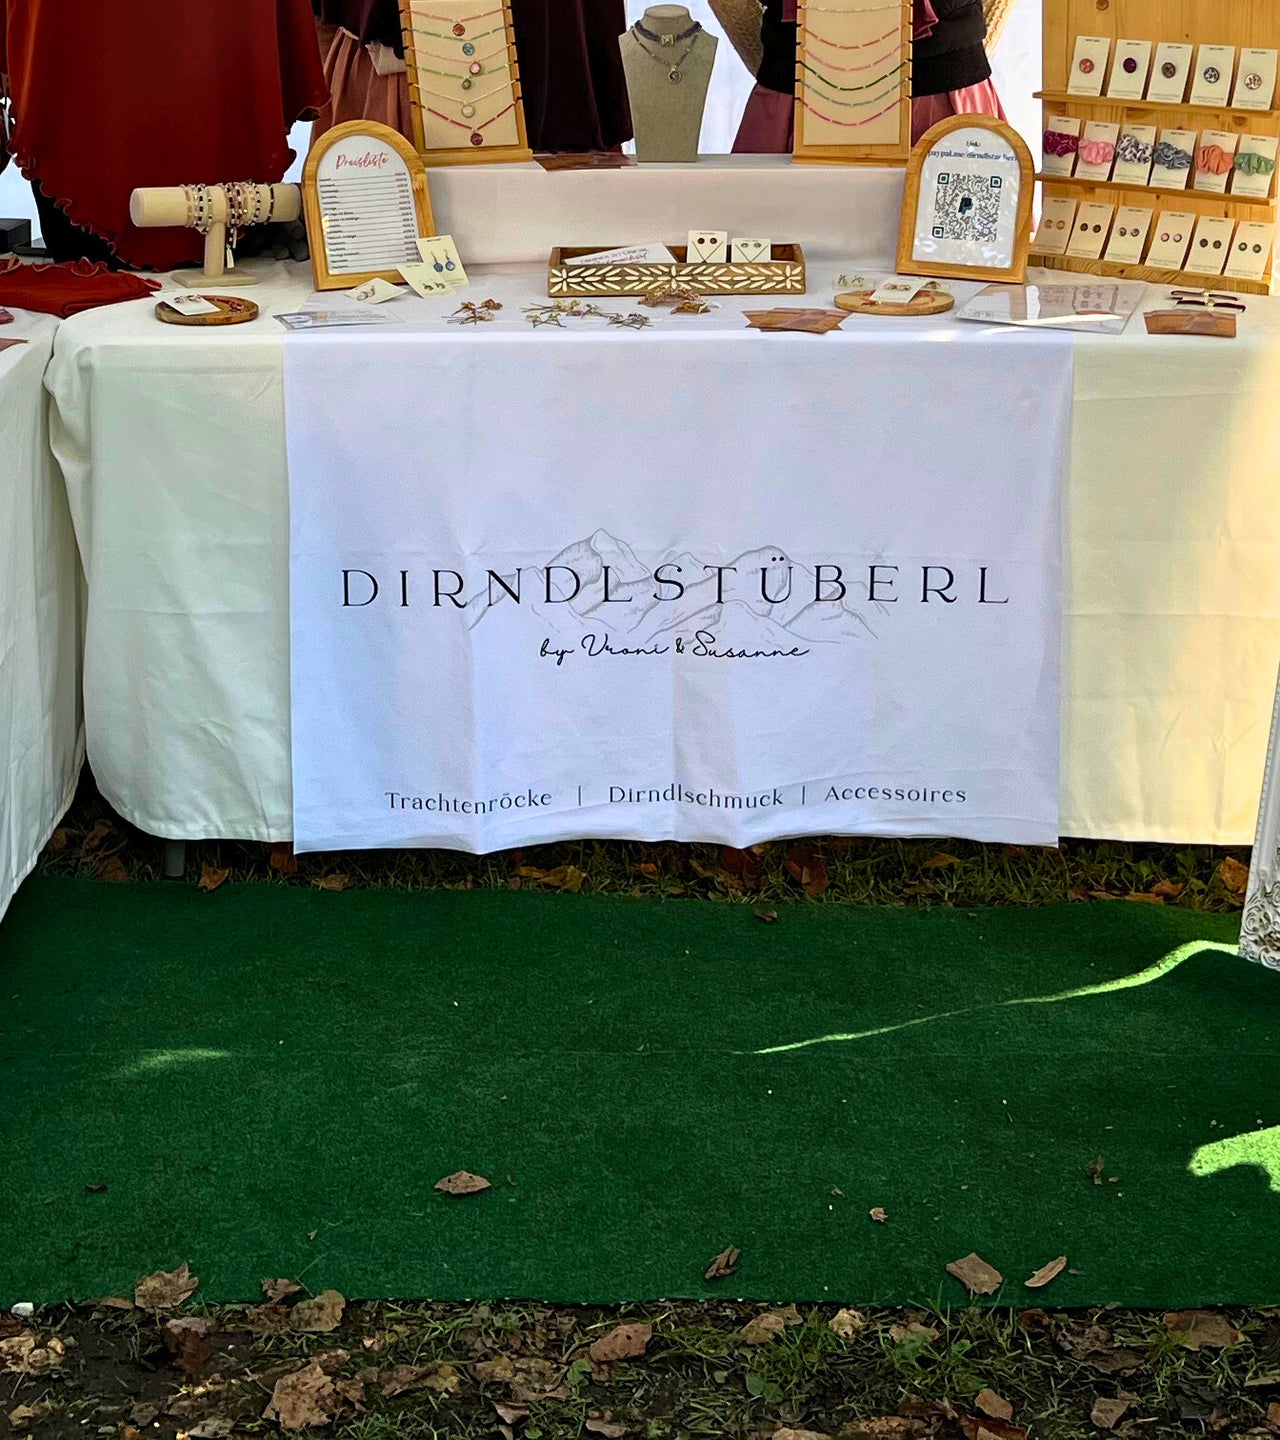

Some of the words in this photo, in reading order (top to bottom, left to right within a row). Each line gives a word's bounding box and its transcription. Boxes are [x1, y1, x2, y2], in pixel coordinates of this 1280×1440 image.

[341, 556, 1009, 608] DIRNDLSTÜBERL
[540, 637, 574, 666] by
[581, 633, 670, 658] Vroni
[675, 637, 686, 654] &
[692, 630, 810, 658] Susanne
[385, 788, 552, 815] Trachtenröcke
[609, 783, 784, 810] Dirndlschmuck
[824, 786, 967, 803] Accessoires
